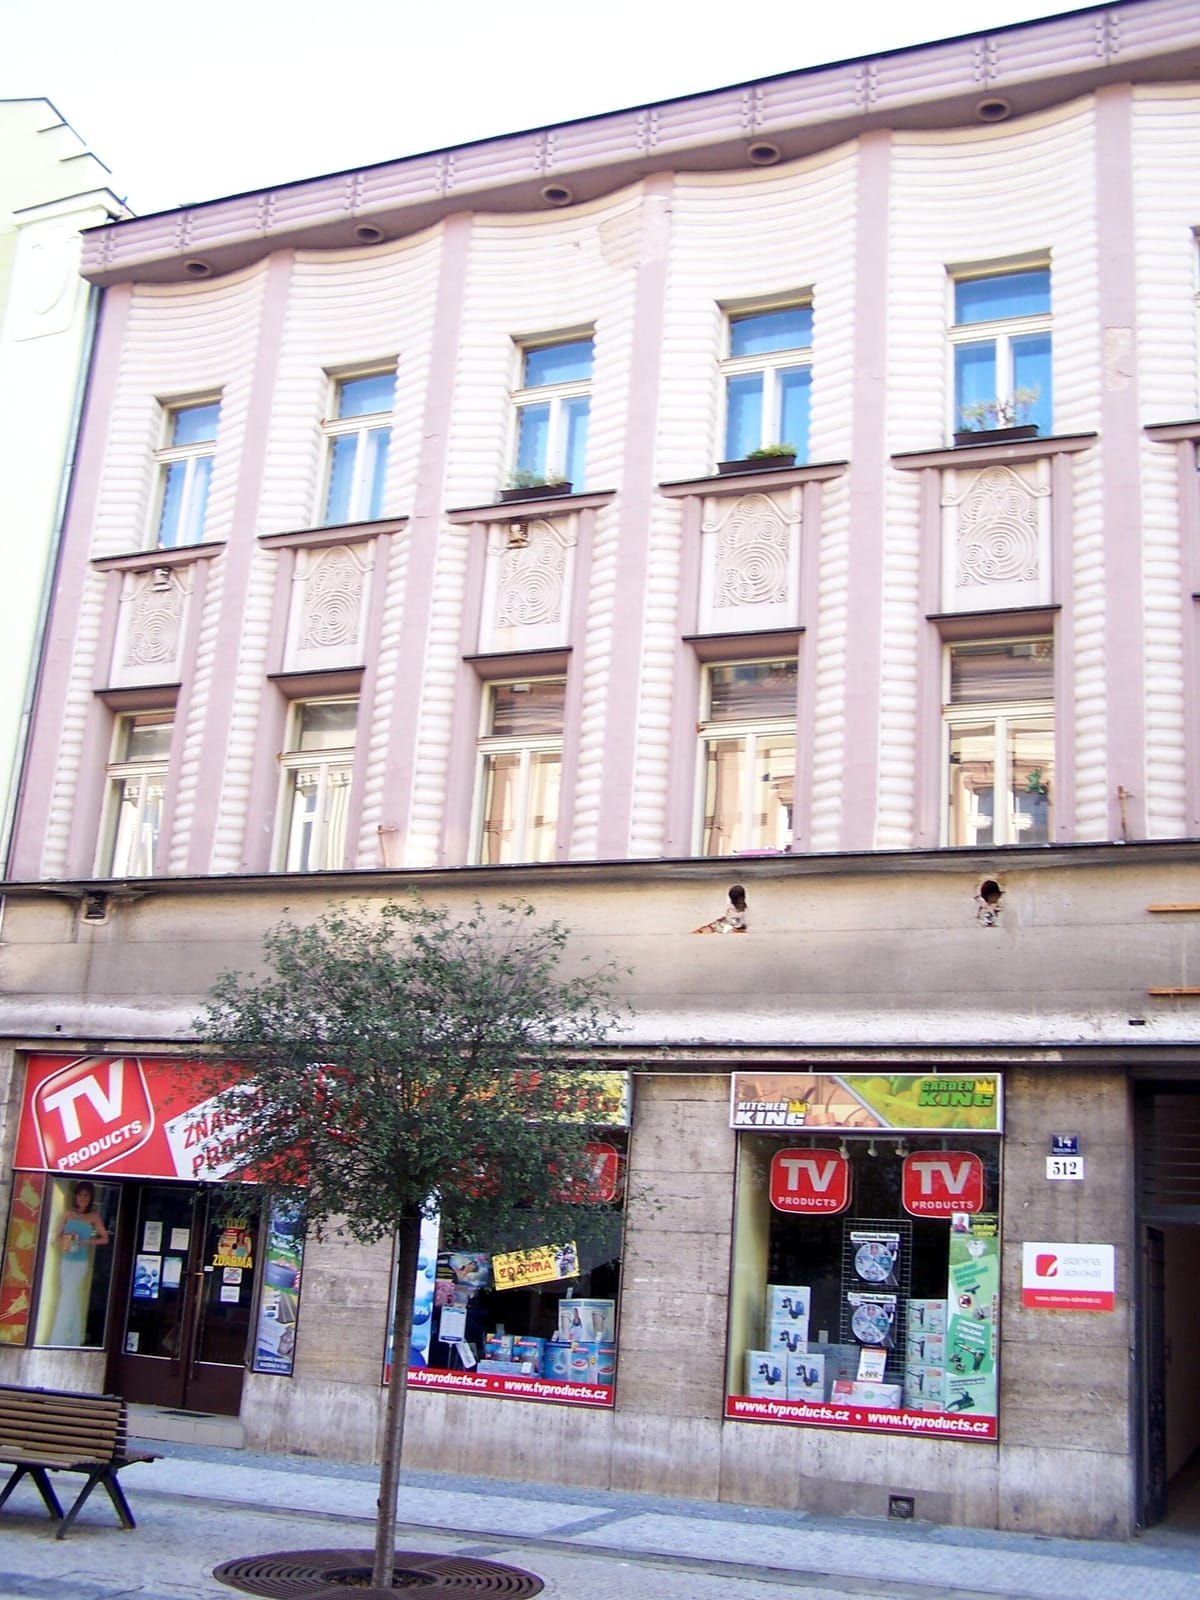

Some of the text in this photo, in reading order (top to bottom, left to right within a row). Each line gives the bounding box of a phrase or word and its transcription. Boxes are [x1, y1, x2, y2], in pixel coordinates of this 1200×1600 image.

[921, 1080, 975, 1093] GARDEN
[43, 1058, 125, 1143] TV
[738, 1101, 788, 1112] KITCHEN
[918, 1092, 994, 1107] KING
[735, 1111, 806, 1126] KING
[57, 1119, 143, 1170] PRODUCTS
[779, 1158, 838, 1193] TV
[1052, 1162, 1077, 1175] 512
[912, 1161, 972, 1195] TV
[778, 1196, 837, 1207] PRODUCTS
[912, 1200, 975, 1210] PRODUCTS
[212, 1254, 253, 1268] ZDARMA
[499, 1260, 552, 1278] ZDARMA
[407, 1369, 608, 1400] w.tvproducts.cz www.tvproducts.cz
[735, 1399, 989, 1433] www.tvproducts.cz www.tvproducts.cz
